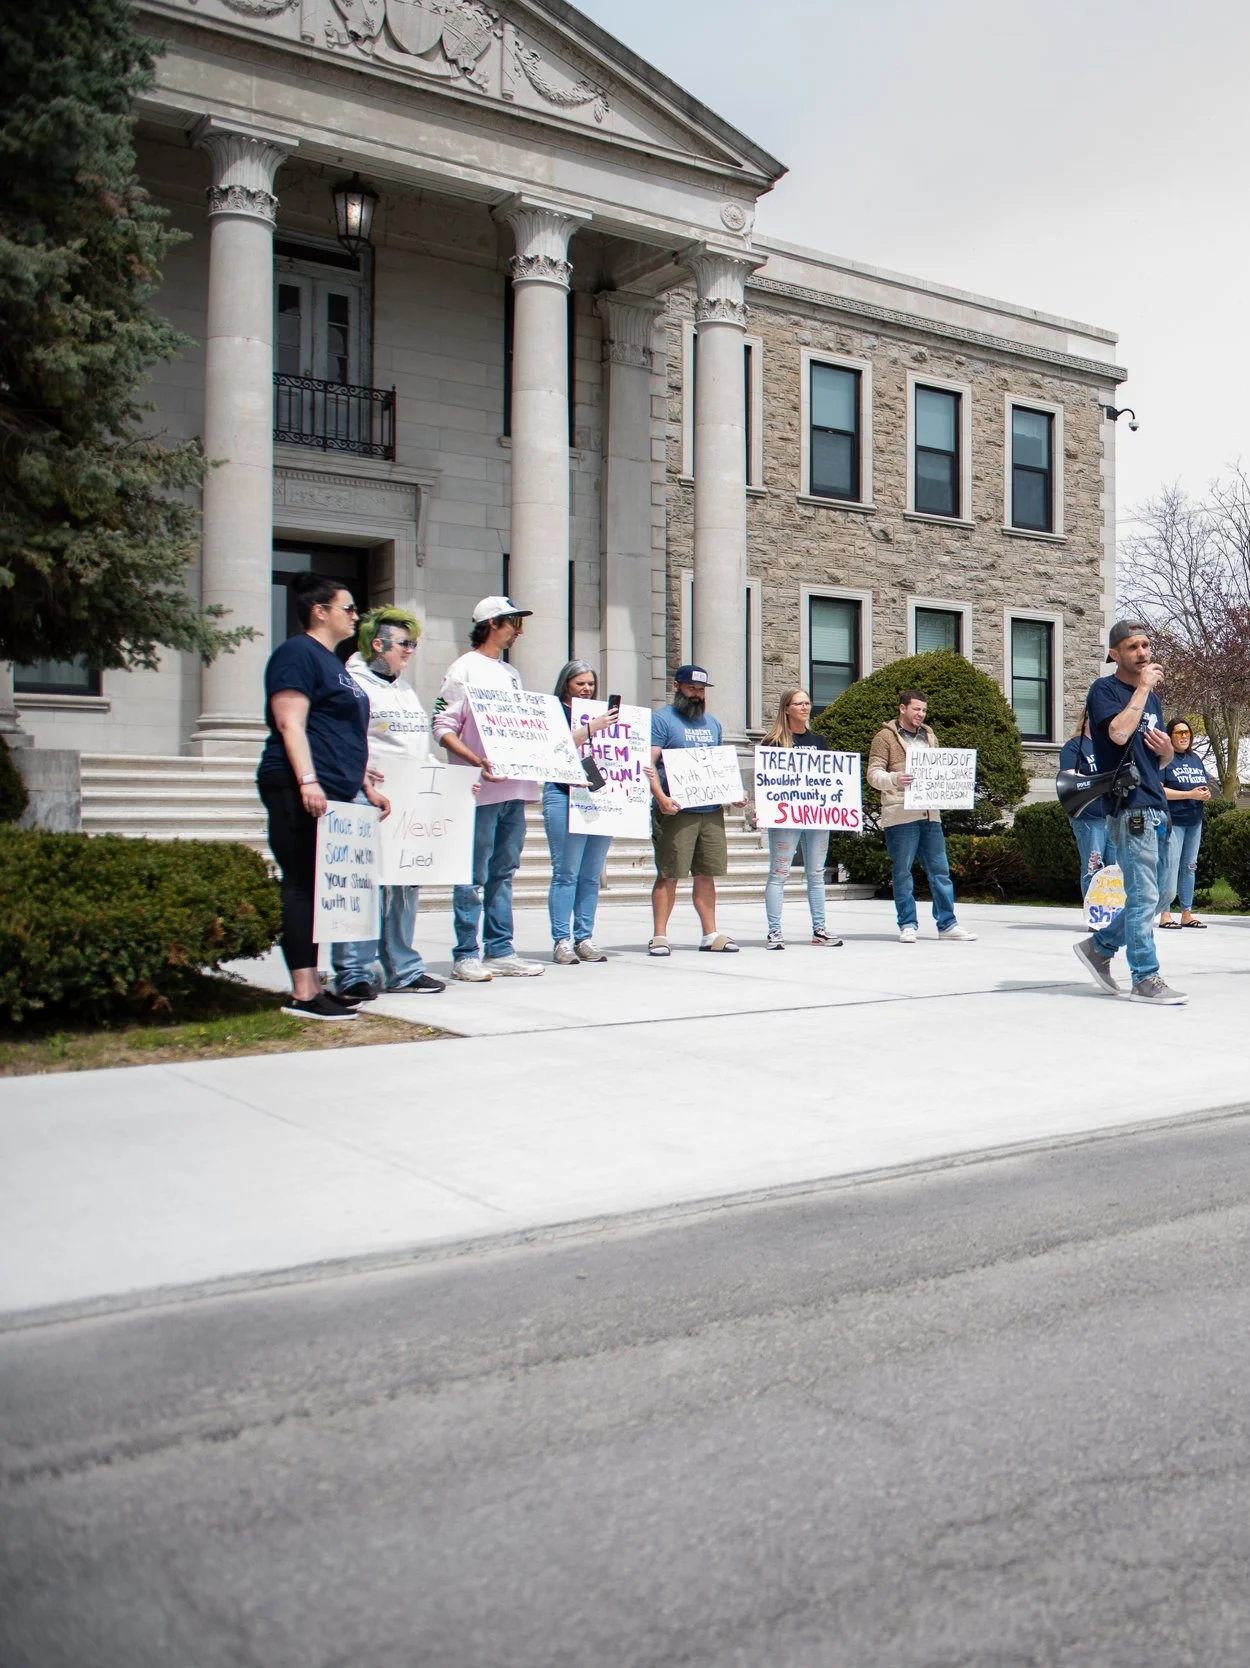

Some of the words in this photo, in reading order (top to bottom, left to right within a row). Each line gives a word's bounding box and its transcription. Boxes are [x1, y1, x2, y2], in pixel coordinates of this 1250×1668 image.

[486, 714, 550, 731] NIGHTMARE
[582, 743, 629, 762] THEM
[911, 752, 959, 767] HUNDREDS
[960, 753, 973, 767] OF
[599, 760, 641, 782] OWN!
[760, 751, 857, 775] TREATMENT
[1172, 767, 1203, 777] ACADEMY
[418, 766, 446, 795] I
[806, 775, 832, 787] leave
[951, 767, 974, 780] SHARE
[1177, 775, 1189, 783] IVY
[925, 781, 945, 791] SAME
[926, 791, 939, 800] NO
[940, 790, 968, 800] REASON
[766, 788, 826, 807] community
[831, 789, 844, 803] of
[393, 808, 454, 840] Never
[774, 802, 859, 828] SURVIVORS
[399, 848, 433, 869] Lied
[324, 872, 347, 890] your
[321, 893, 346, 911] with
[1089, 905, 1124, 924] Shi
